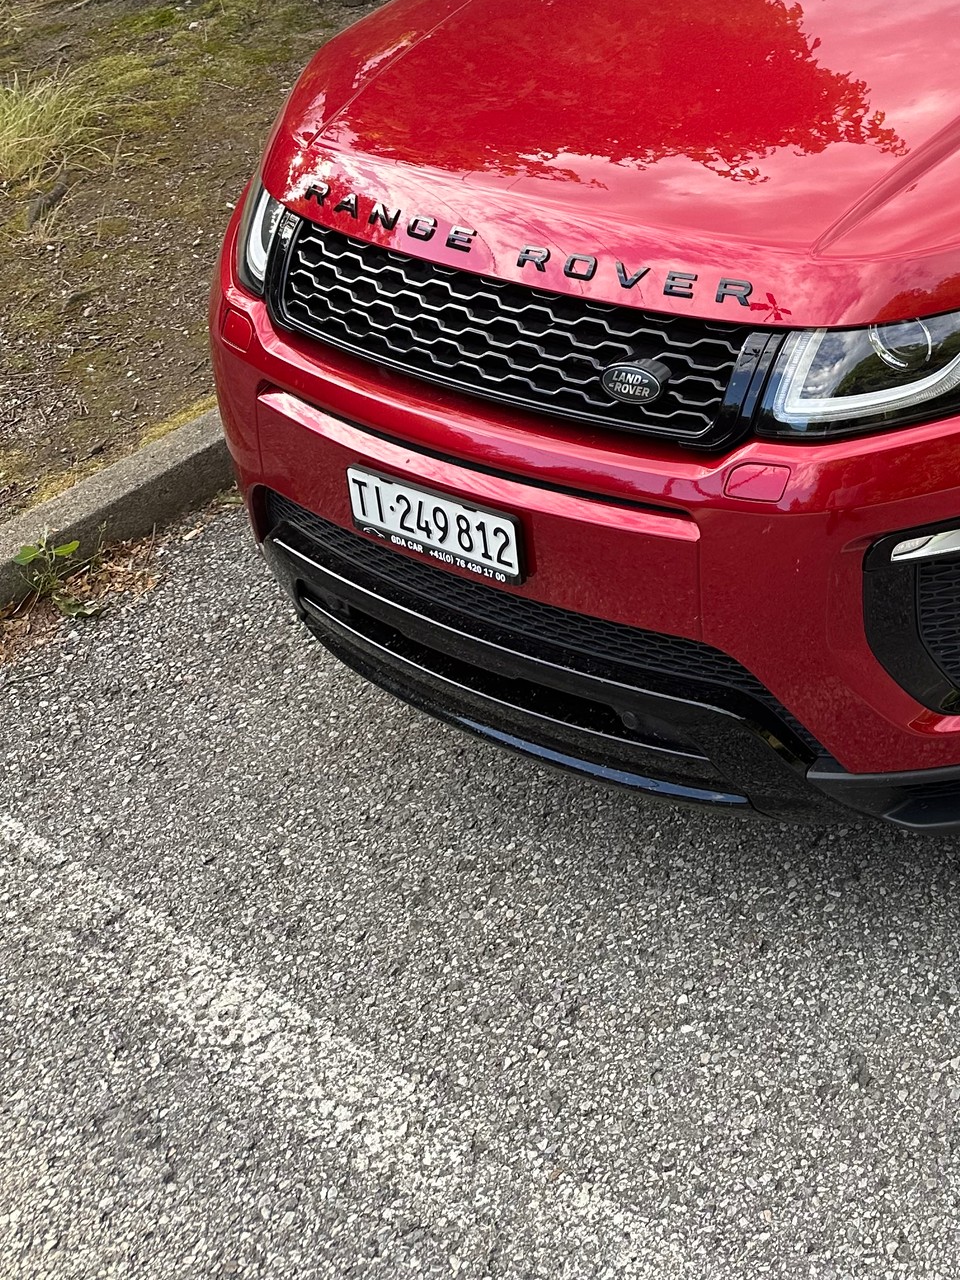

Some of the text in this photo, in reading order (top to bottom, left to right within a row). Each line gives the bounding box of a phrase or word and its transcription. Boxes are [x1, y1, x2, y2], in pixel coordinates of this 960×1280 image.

[305, 179, 753, 307] RANGE ROVER
[612, 370, 642, 385] LAND
[614, 382, 650, 397] ROVER
[407, 541, 423, 553] CAR
[429, 550, 454, 564] +41(0)
[455, 557, 466, 568] 76
[467, 562, 482, 574] 420
[483, 568, 493, 578] 17
[495, 572, 506, 582] 00
